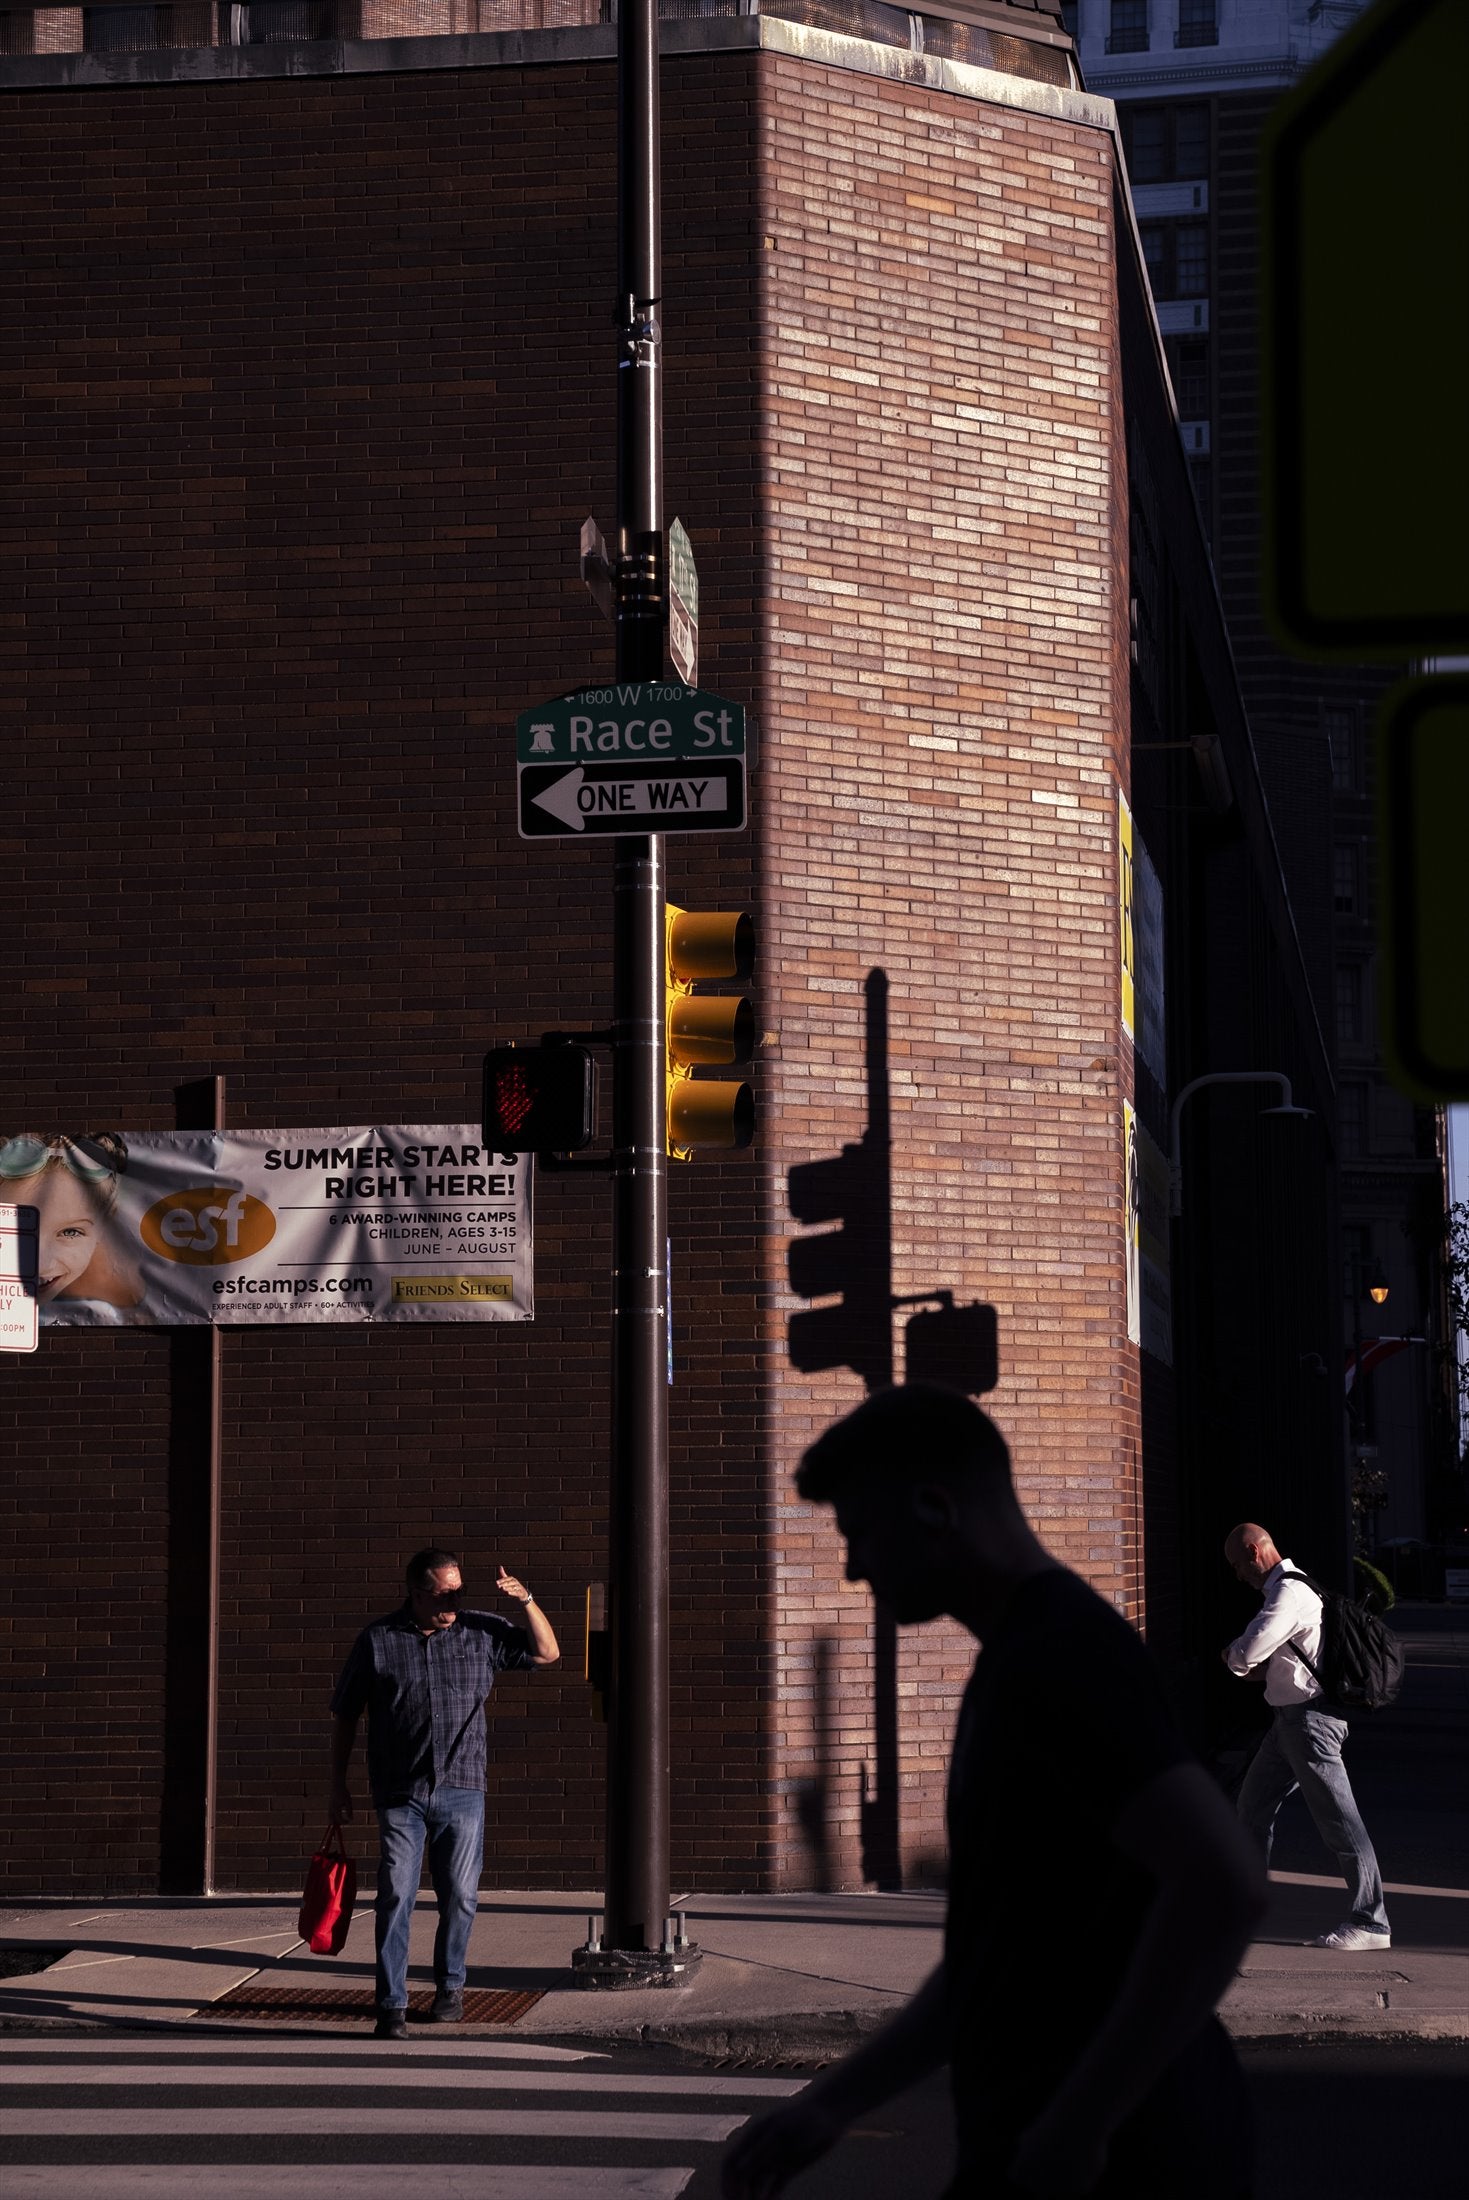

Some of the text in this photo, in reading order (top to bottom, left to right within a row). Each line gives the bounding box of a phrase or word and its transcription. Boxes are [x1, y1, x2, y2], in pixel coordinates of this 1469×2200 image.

[579, 685, 682, 706] 1600 W 1700
[569, 709, 734, 752] Race St
[576, 781, 709, 812] ONE WAY
[263, 1145, 519, 1170] SUMMER STARTS
[325, 1174, 515, 1199] RIGHT HERE!
[160, 1191, 247, 1251] esf
[329, 1212, 516, 1225] 6 AWARD-WINNING CAMPS
[369, 1227, 516, 1239] CHILDREN, AGES 3-15
[403, 1244, 441, 1254] JUNE
[457, 1243, 517, 1254] AUGUST
[212, 1276, 373, 1296] esfcamps.com
[263, 1302, 288, 1310] ADULT
[320, 1301, 334, 1309] 60+
